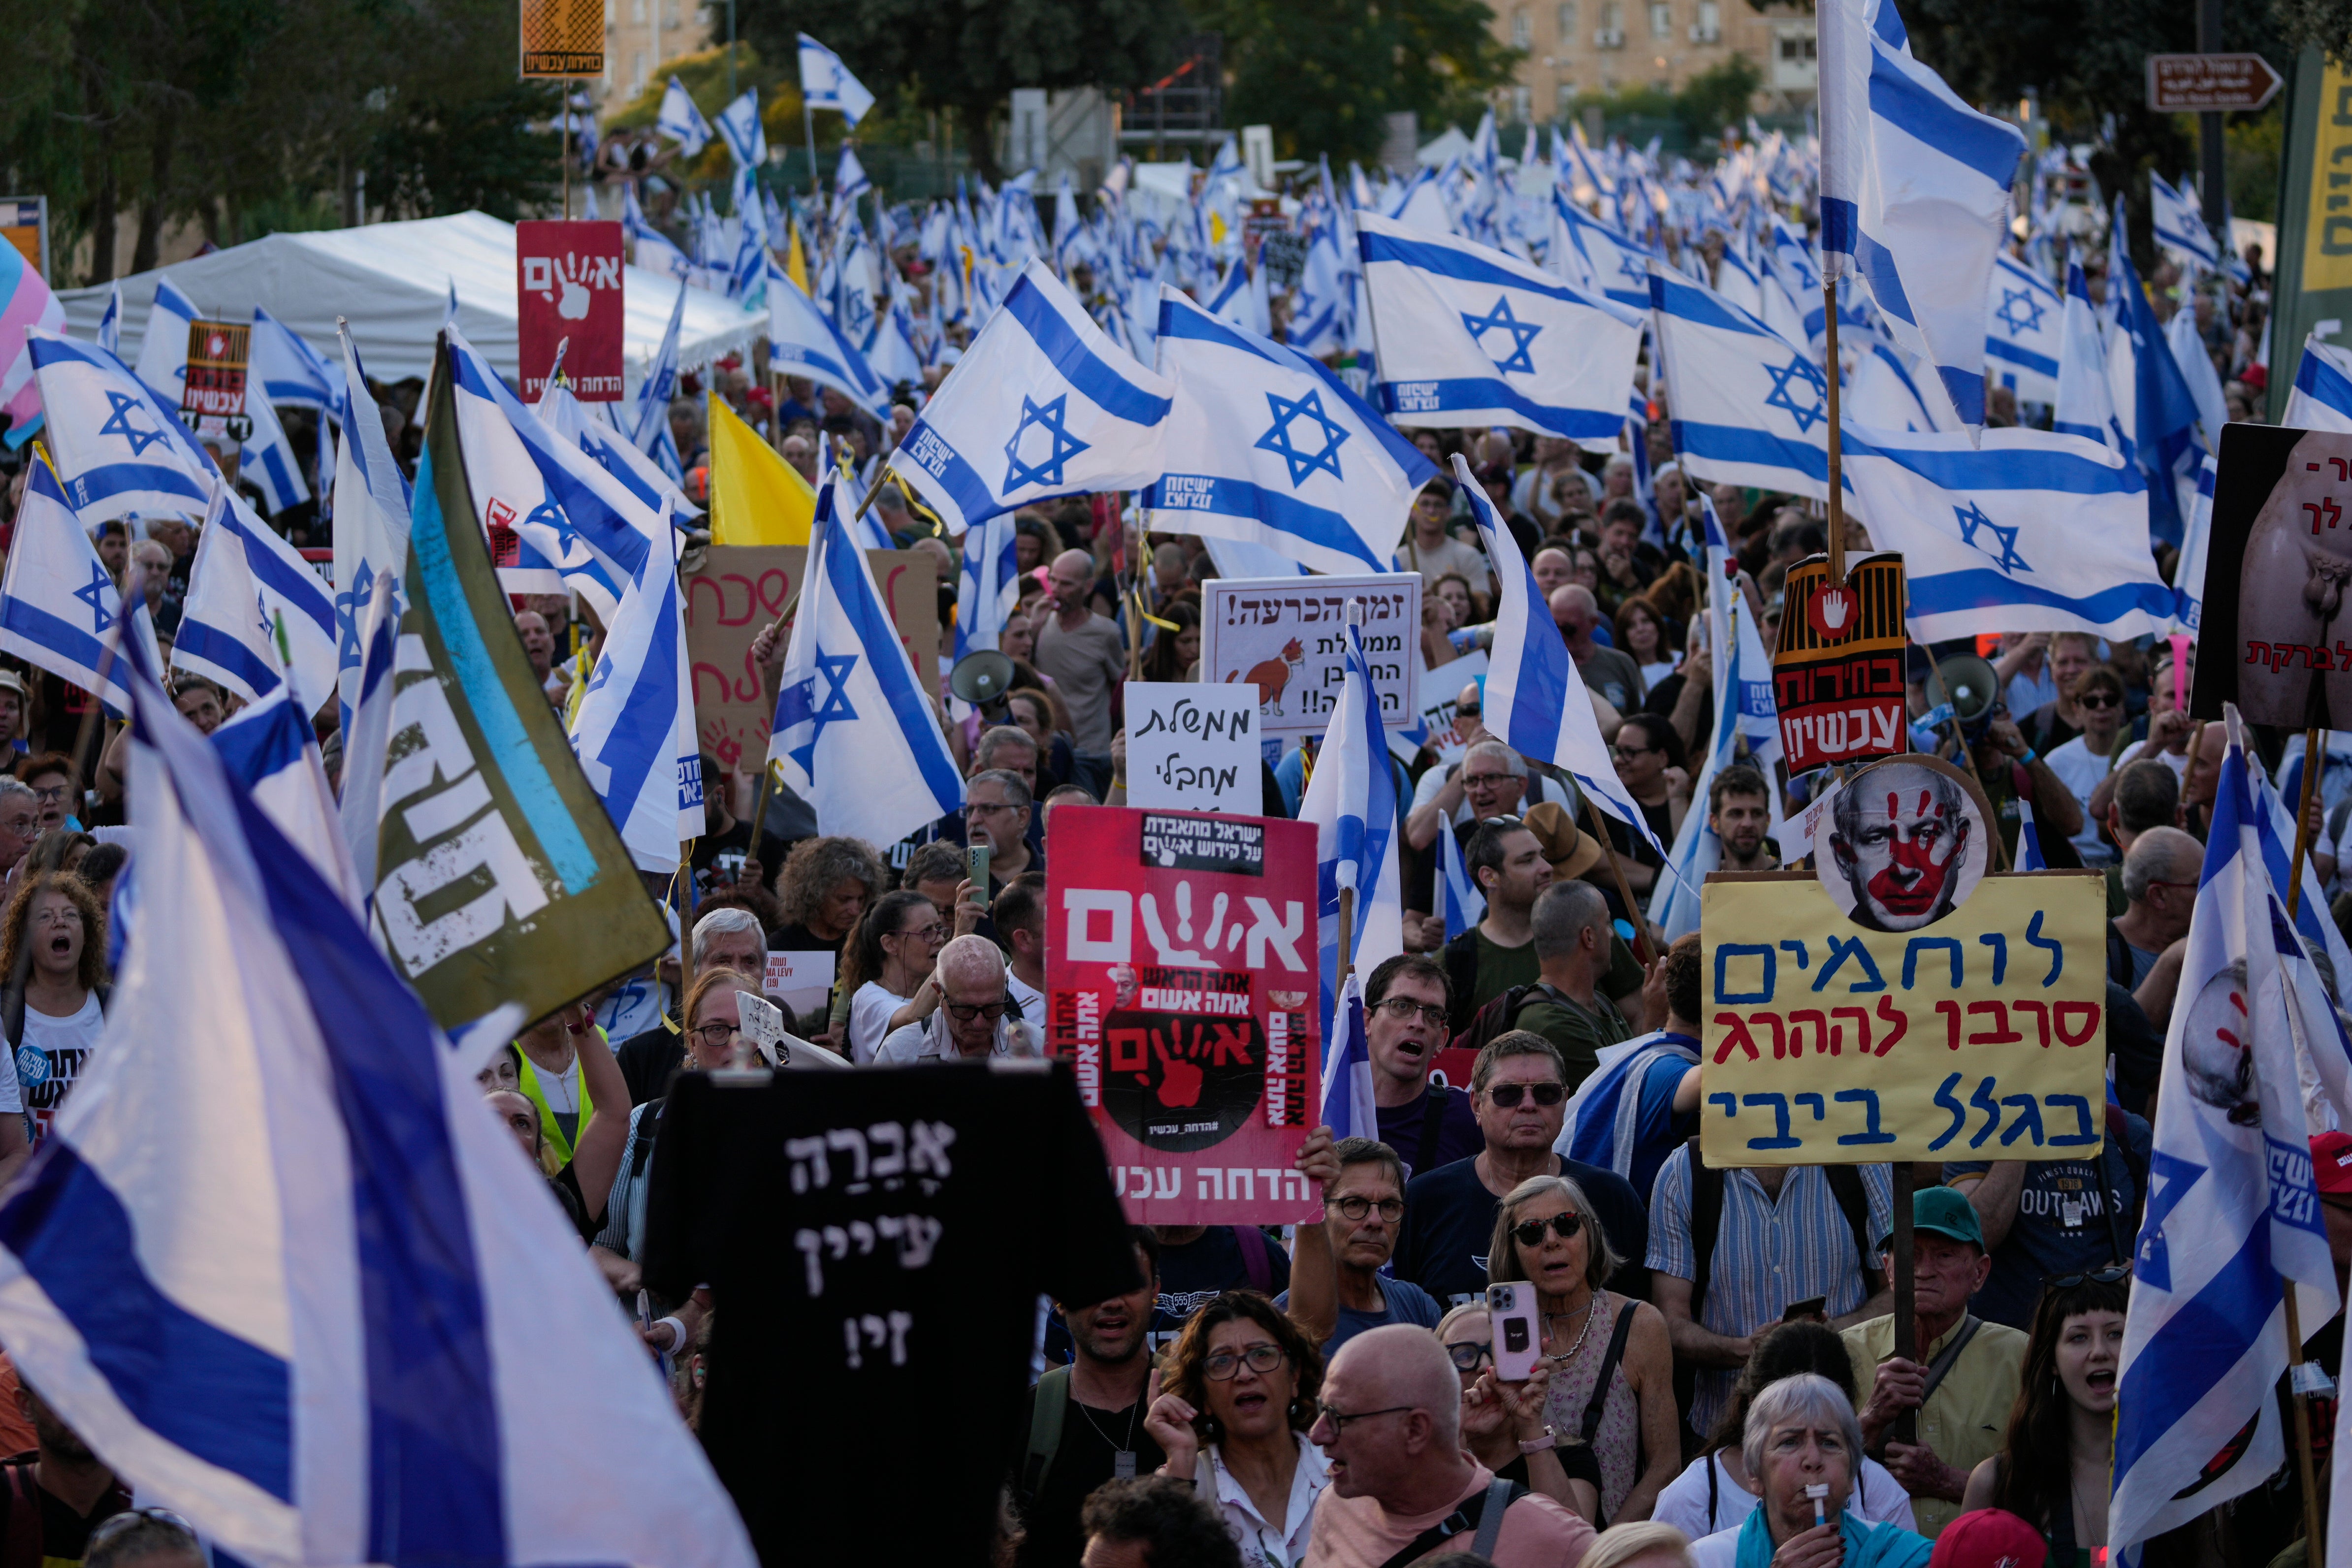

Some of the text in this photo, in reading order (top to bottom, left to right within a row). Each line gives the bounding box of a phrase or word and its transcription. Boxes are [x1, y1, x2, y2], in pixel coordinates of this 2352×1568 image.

[526, 54, 602, 71] בחירות עכשיו!
[581, 376, 621, 392] הדחה
[1227, 594, 1404, 626] זמן הכרעה!
[1776, 658, 1904, 707] בחירות
[1134, 698, 1250, 741] ממשלת
[1784, 705, 1901, 763] עכשיו!
[1156, 752, 1238, 796] מחבלי
[1144, 816, 1261, 843] ישראל מתאבדת
[1197, 840, 1240, 860] קידוש
[1243, 843, 1262, 862] על
[771, 957, 787, 966] נעמה
[777, 967, 793, 977] LEVY
[1713, 910, 2063, 1004] לוחמים
[767, 977, 778, 989] (19)
[1142, 966, 1250, 993] אתה הראש
[1141, 988, 1250, 1015] אתה אשם
[1713, 994, 2101, 1064] סרבו לההרג
[1077, 992, 1099, 1106] אתה אשם
[1267, 1011, 1287, 1125] אתה אשם
[1287, 1012, 1306, 1125] אתה הראש
[1708, 1072, 2101, 1152] בגלל ביבי
[1197, 1167, 1310, 1201] הדחה
[794, 1213, 943, 1298] עדיין
[1174, 1295, 1188, 1306] 555
